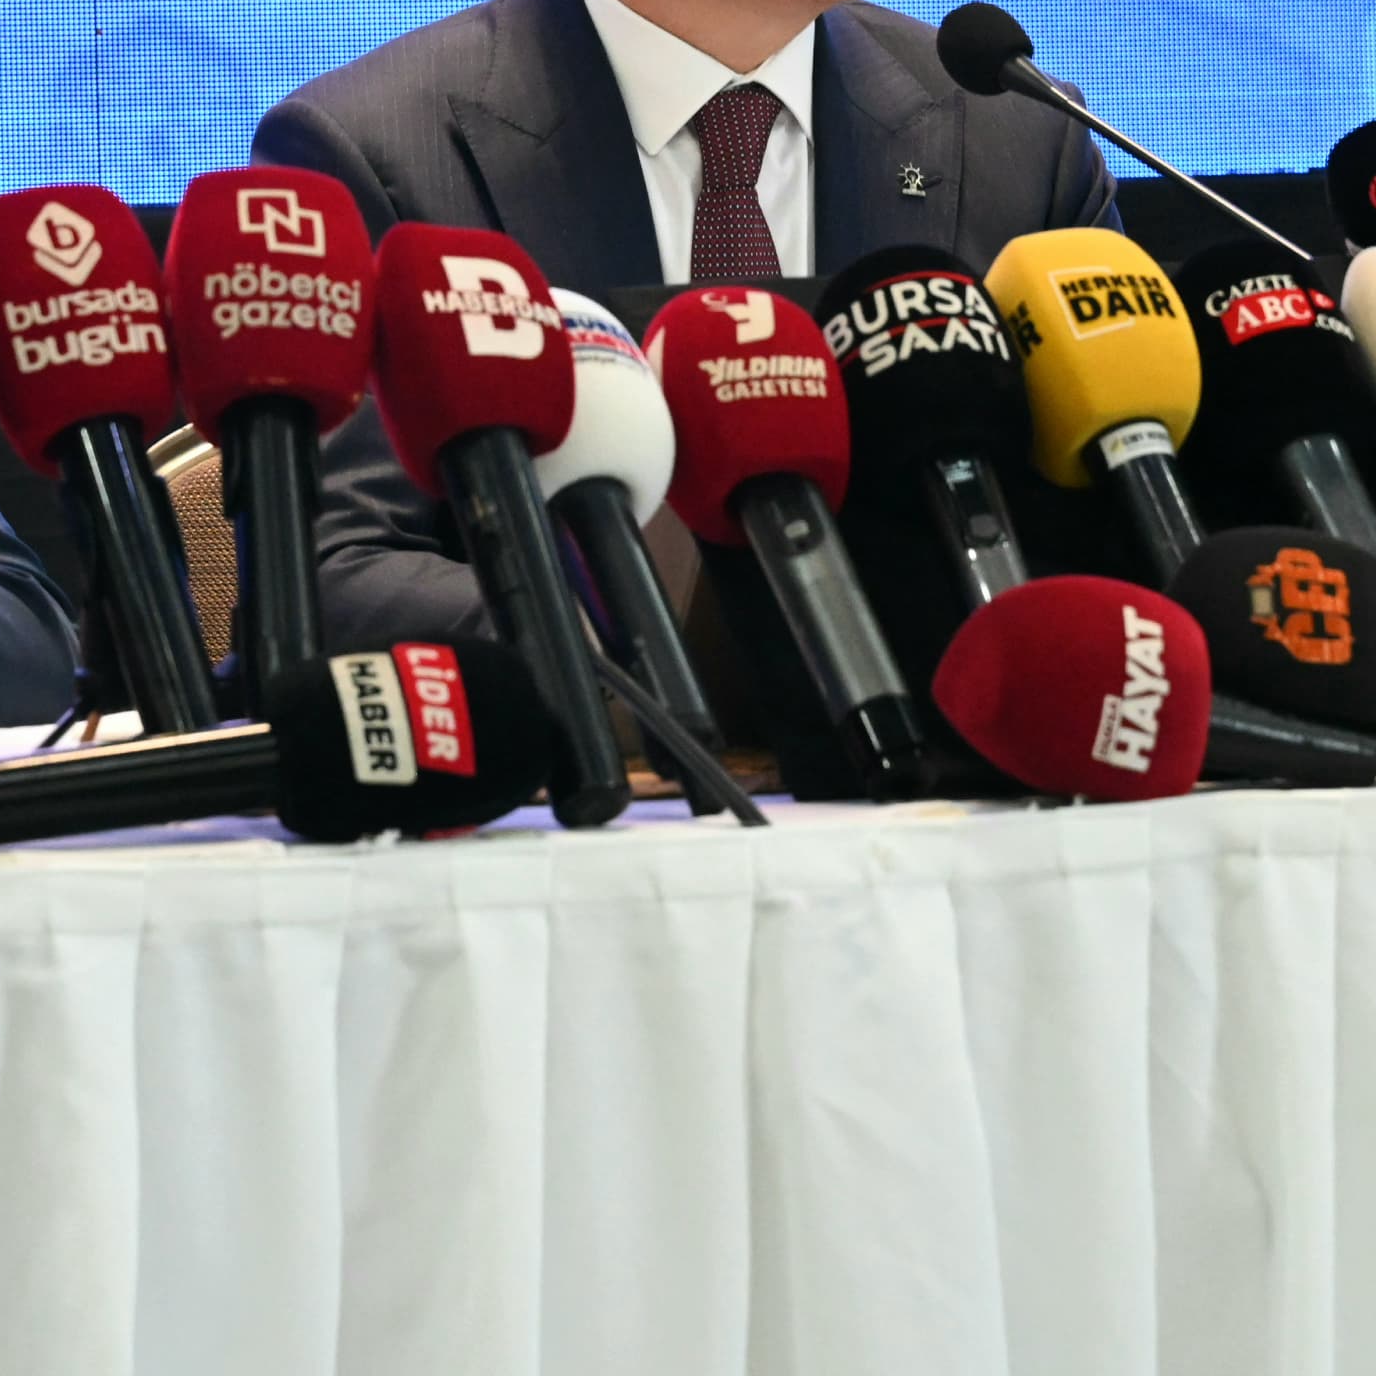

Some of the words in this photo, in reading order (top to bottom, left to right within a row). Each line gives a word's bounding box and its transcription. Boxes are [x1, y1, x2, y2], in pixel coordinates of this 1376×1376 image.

[4, 280, 159, 332] bursada
[212, 300, 357, 340] gazete
[823, 277, 998, 357] BURSA
[1205, 274, 1300, 317] GAZETE
[1236, 293, 1313, 334] ABC
[12, 315, 167, 374] bugün
[698, 356, 827, 387] YILDIRIM
[1106, 604, 1172, 774] HAYAT
[345, 660, 398, 773] HABER
